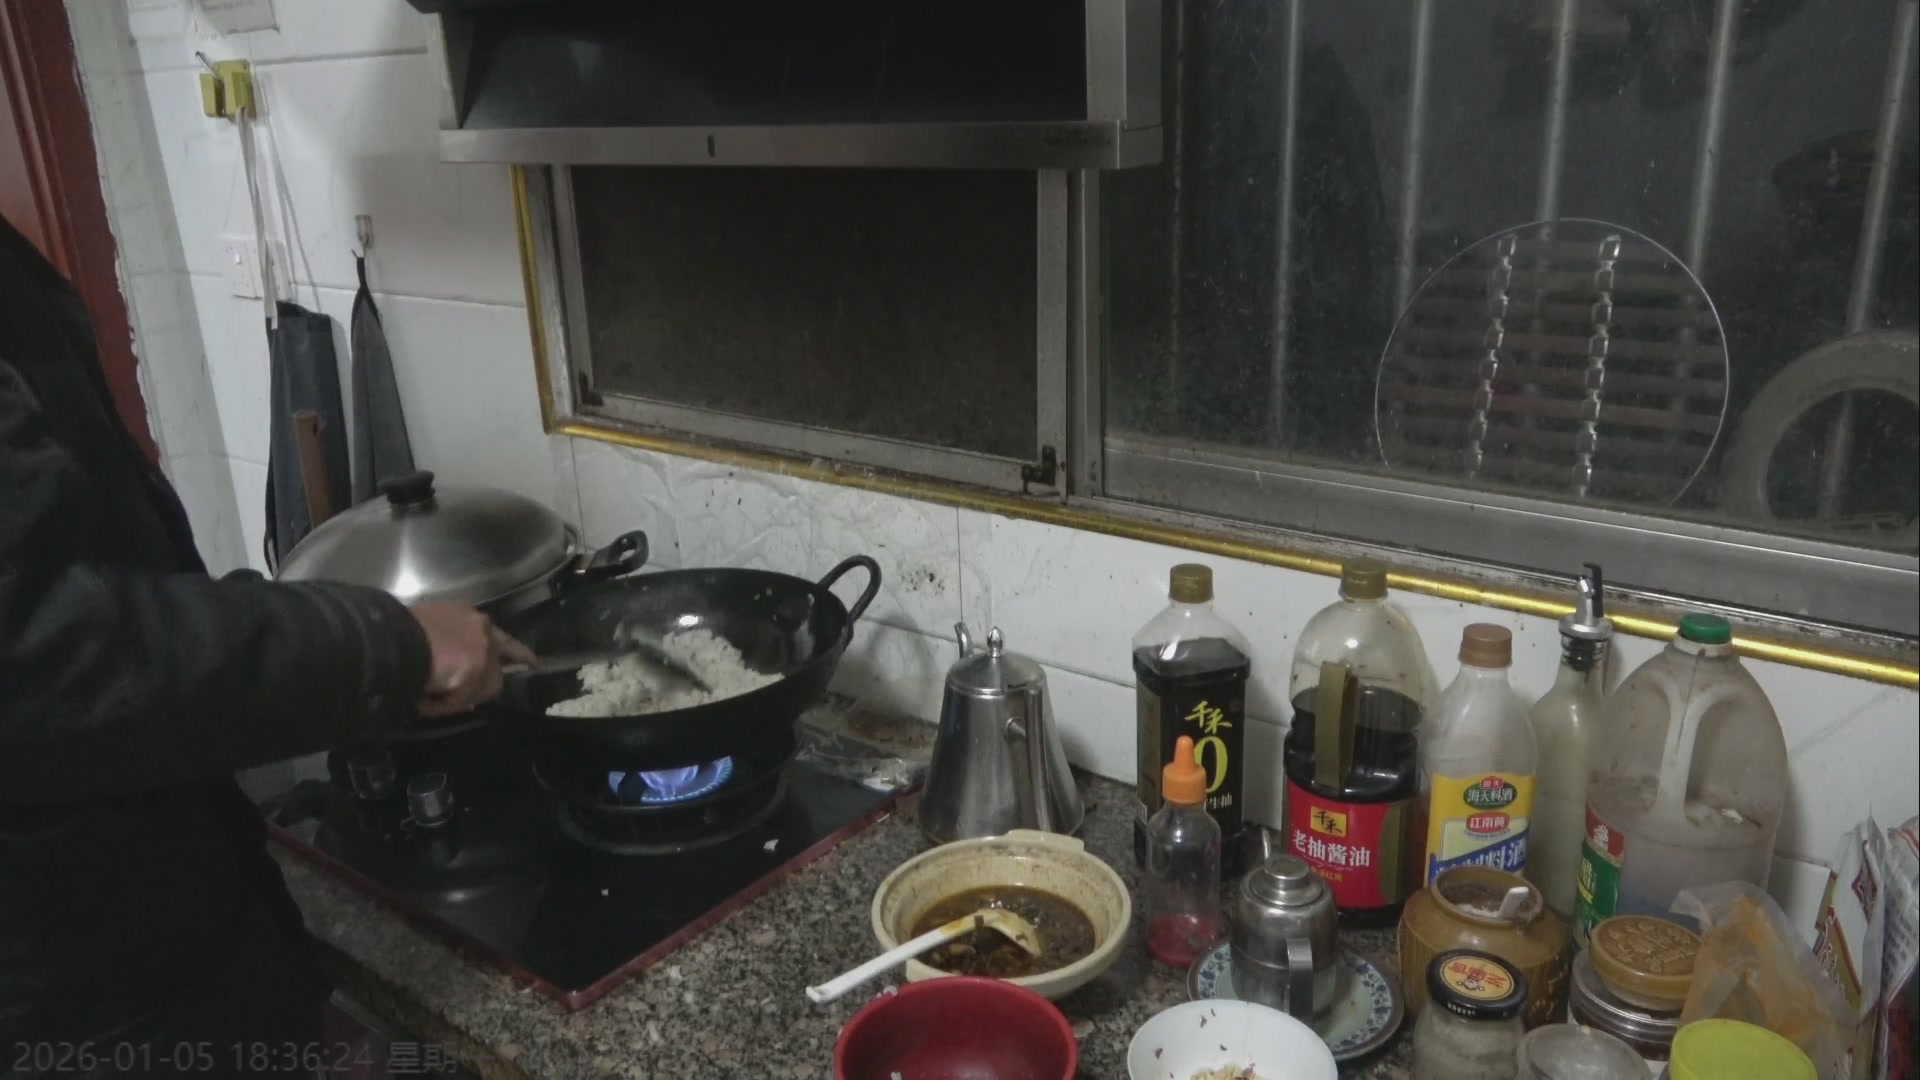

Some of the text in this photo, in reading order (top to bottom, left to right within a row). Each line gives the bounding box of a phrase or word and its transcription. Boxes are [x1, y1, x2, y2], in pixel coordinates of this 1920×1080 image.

[1194, 736, 1229, 793] 0
[1467, 787, 1513, 802] 海天料酒
[1292, 829, 1371, 867] 老抽酱油
